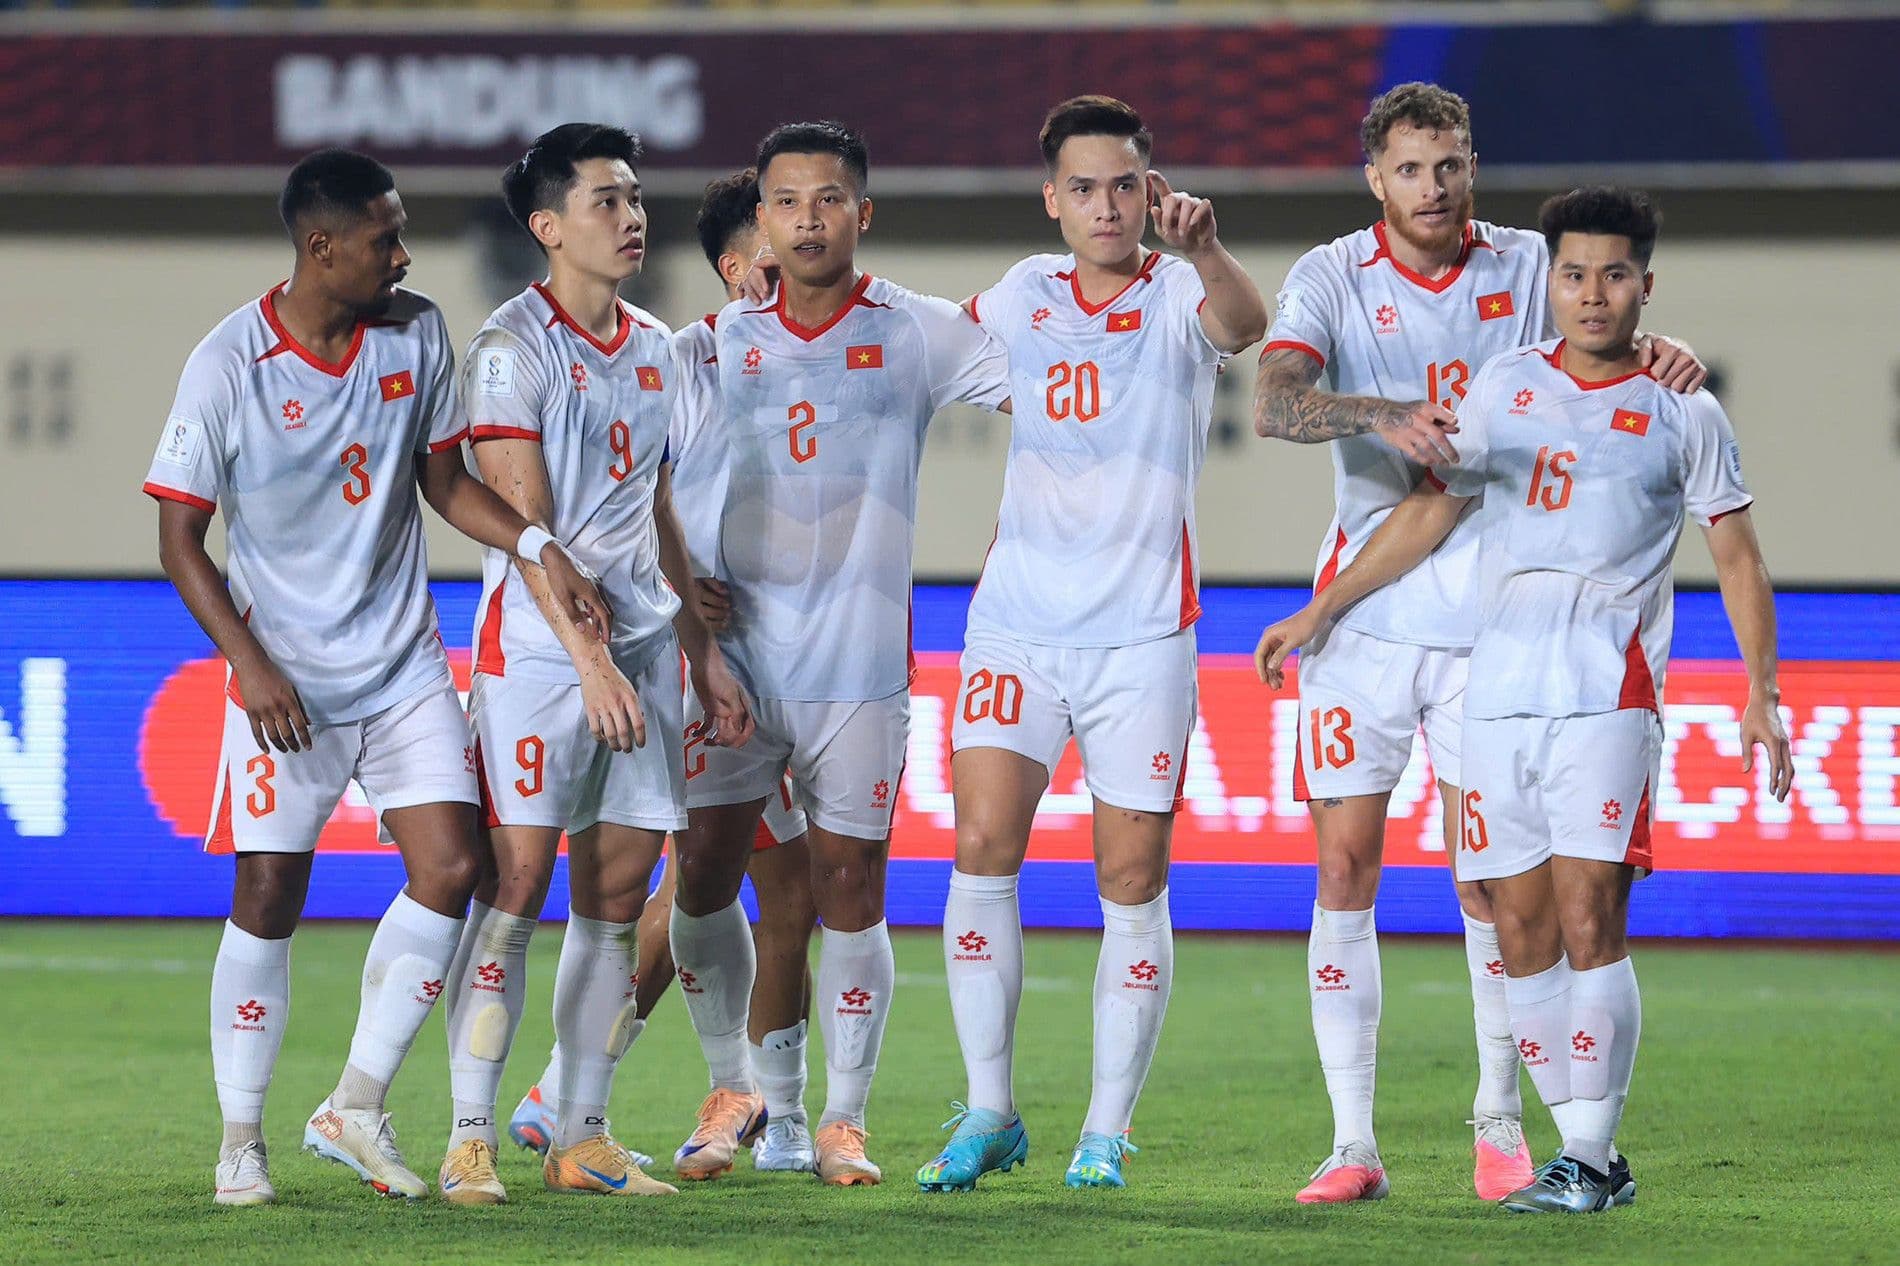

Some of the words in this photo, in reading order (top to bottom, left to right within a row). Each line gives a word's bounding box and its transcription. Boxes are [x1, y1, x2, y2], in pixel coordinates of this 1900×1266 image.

[274, 53, 704, 150] BANDUNG
[1046, 360, 1100, 423] 20
[1426, 359, 1470, 412] 13
[609, 420, 633, 482] 9
[787, 400, 817, 464] 2
[340, 442, 372, 506] 3
[1526, 445, 1577, 512] 15
[963, 668, 1024, 726] 20
[514, 735, 545, 798] 9
[1310, 705, 1356, 770] 13
[246, 753, 276, 818] 3
[1461, 788, 1489, 853] 15
